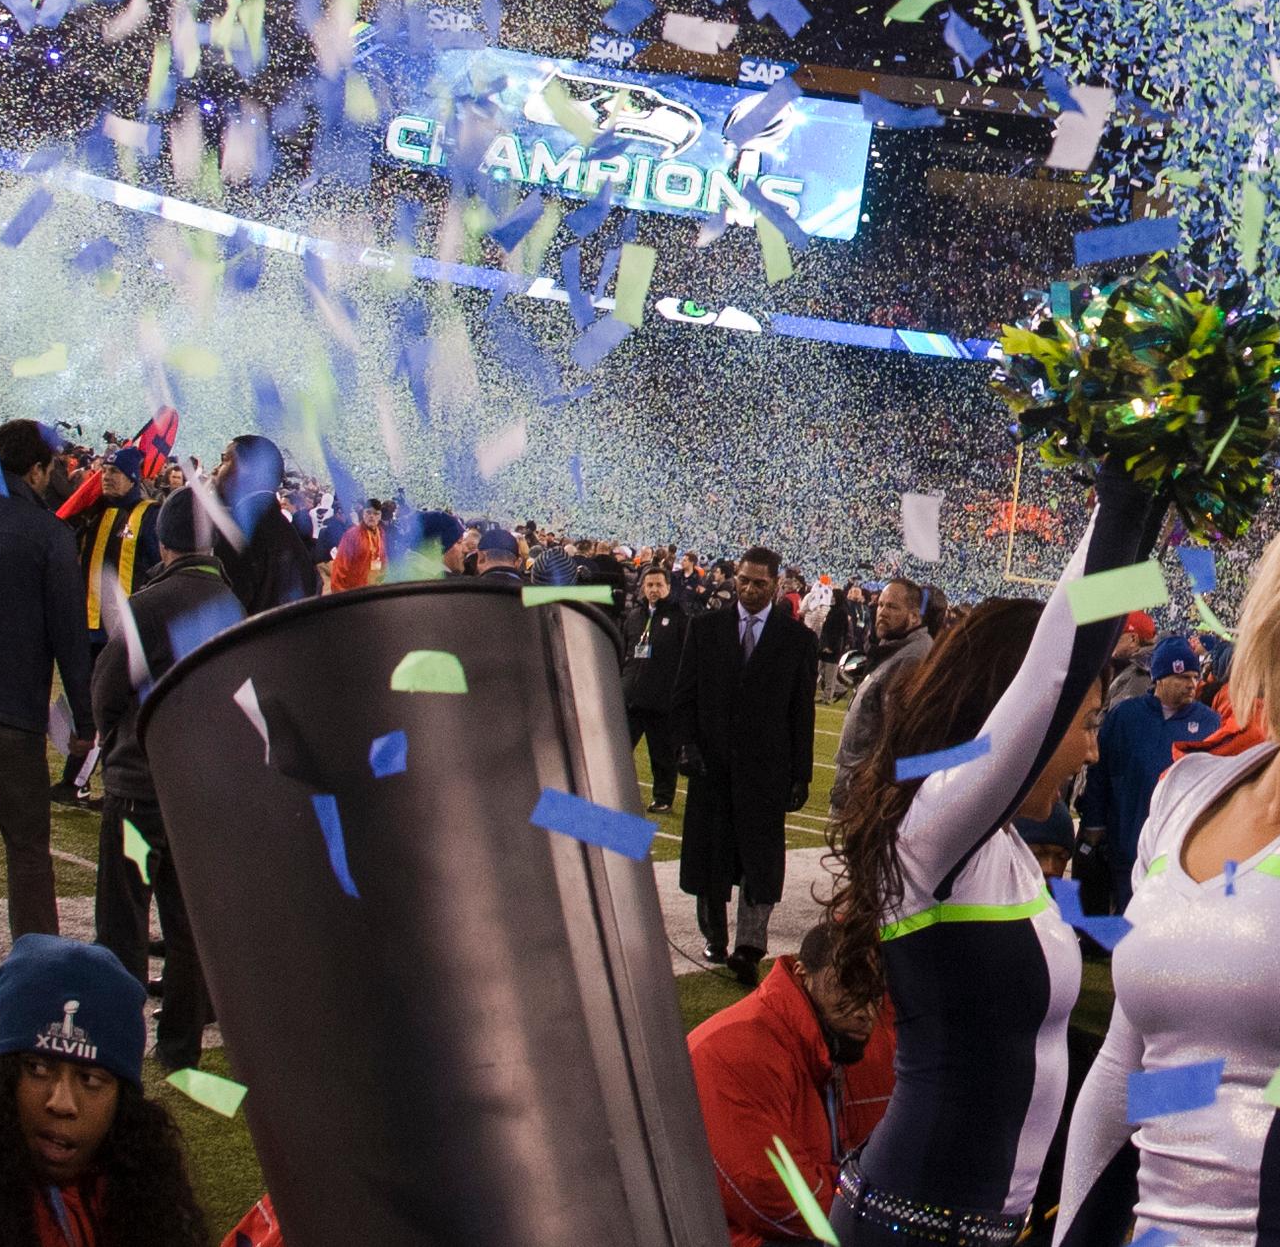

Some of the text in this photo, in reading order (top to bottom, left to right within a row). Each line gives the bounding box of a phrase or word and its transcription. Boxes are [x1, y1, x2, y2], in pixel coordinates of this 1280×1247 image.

[589, 37, 636, 63] SAP
[740, 60, 786, 85] SAP
[35, 1034, 98, 1060] XLVIII
